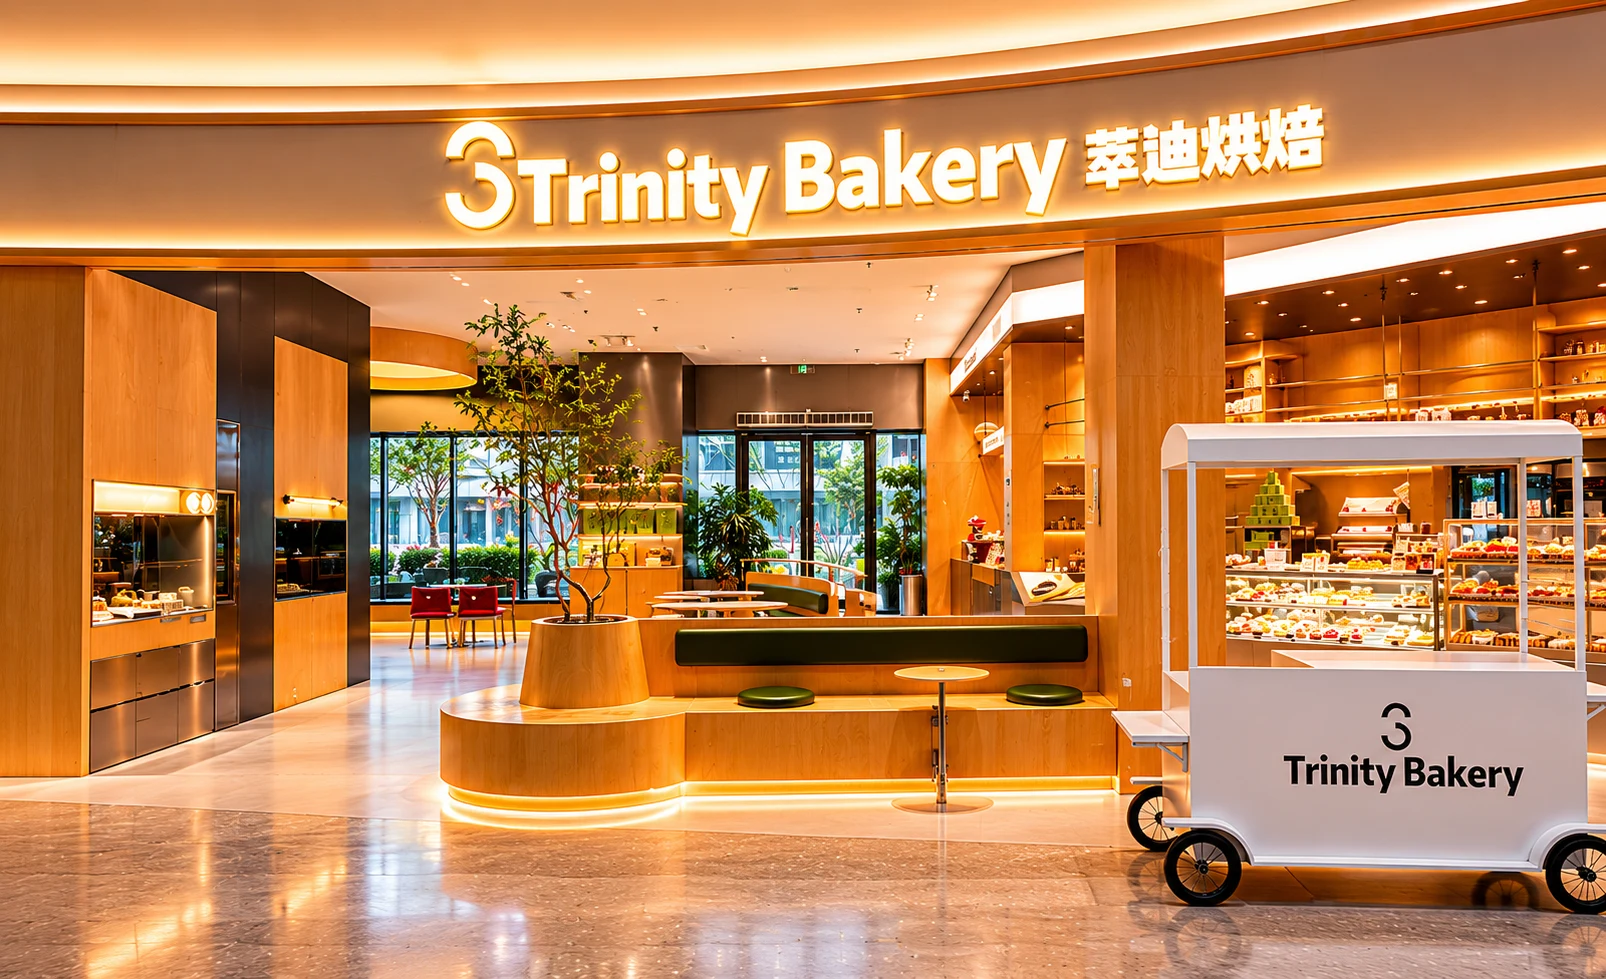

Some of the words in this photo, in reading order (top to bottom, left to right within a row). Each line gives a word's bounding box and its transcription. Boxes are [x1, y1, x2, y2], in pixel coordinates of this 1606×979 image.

[517, 148, 770, 236] Trinity
[784, 128, 1067, 216] Bakery
[1085, 104, 1325, 191] 萃迪烘焙
[1283, 754, 1396, 794] Trinity
[1404, 755, 1524, 797] Bakery
